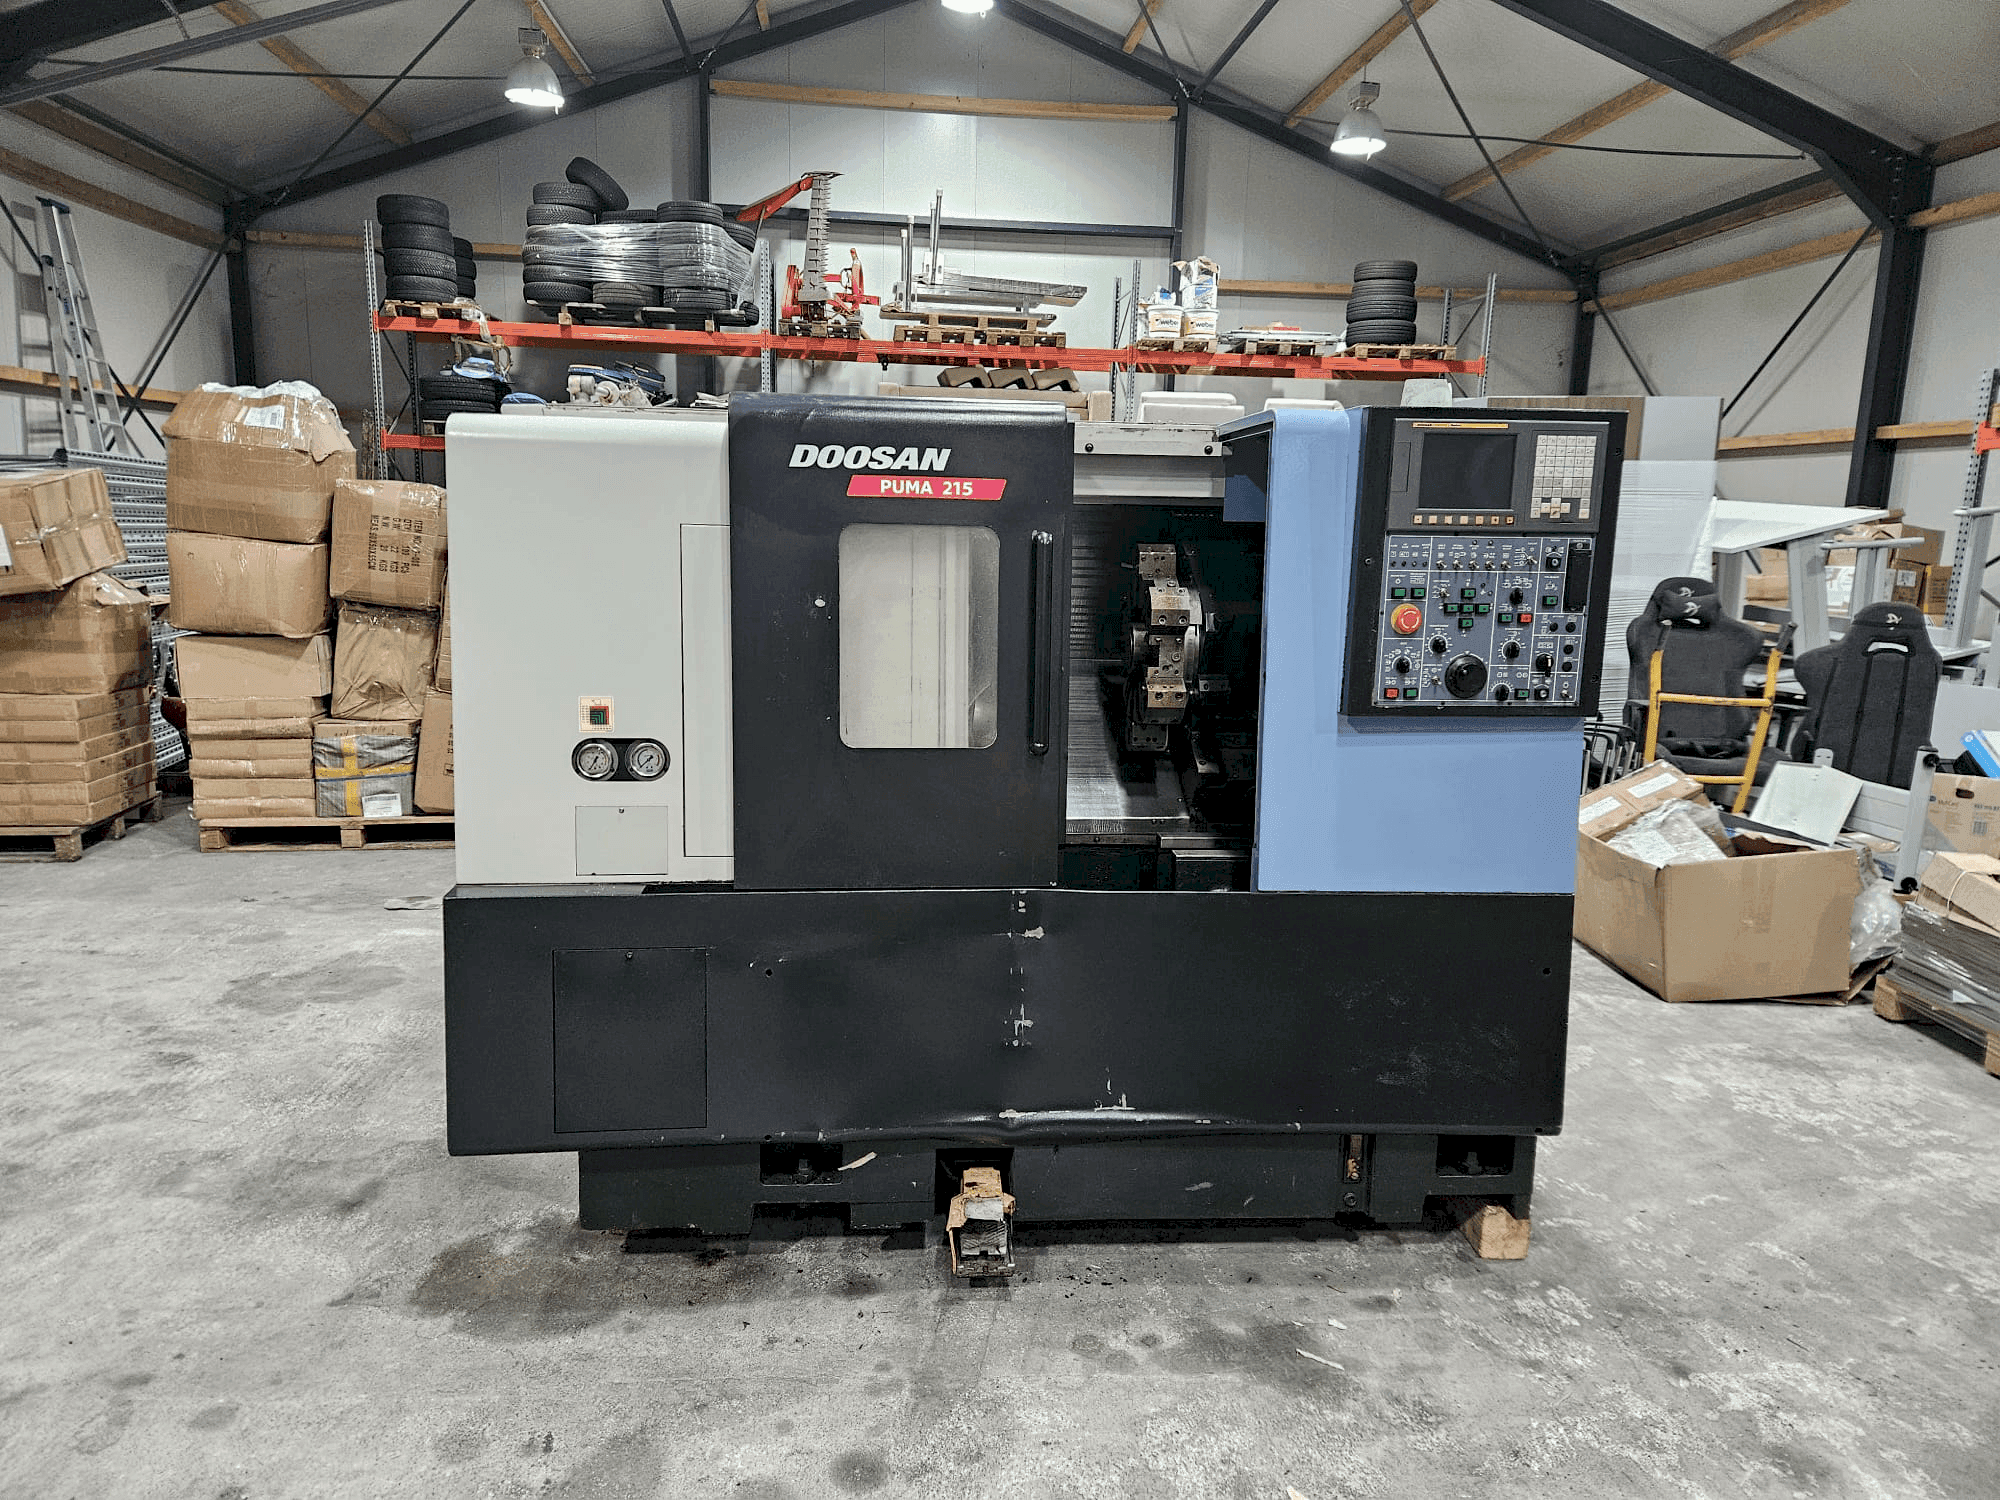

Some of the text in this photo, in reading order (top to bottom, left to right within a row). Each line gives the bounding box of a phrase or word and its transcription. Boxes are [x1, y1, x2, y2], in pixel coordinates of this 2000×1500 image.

[788, 444, 952, 471] DOOSAN
[880, 479, 974, 496] PUMA 215
[379, 559, 388, 572] KGS
[389, 560, 399, 573] KGS
